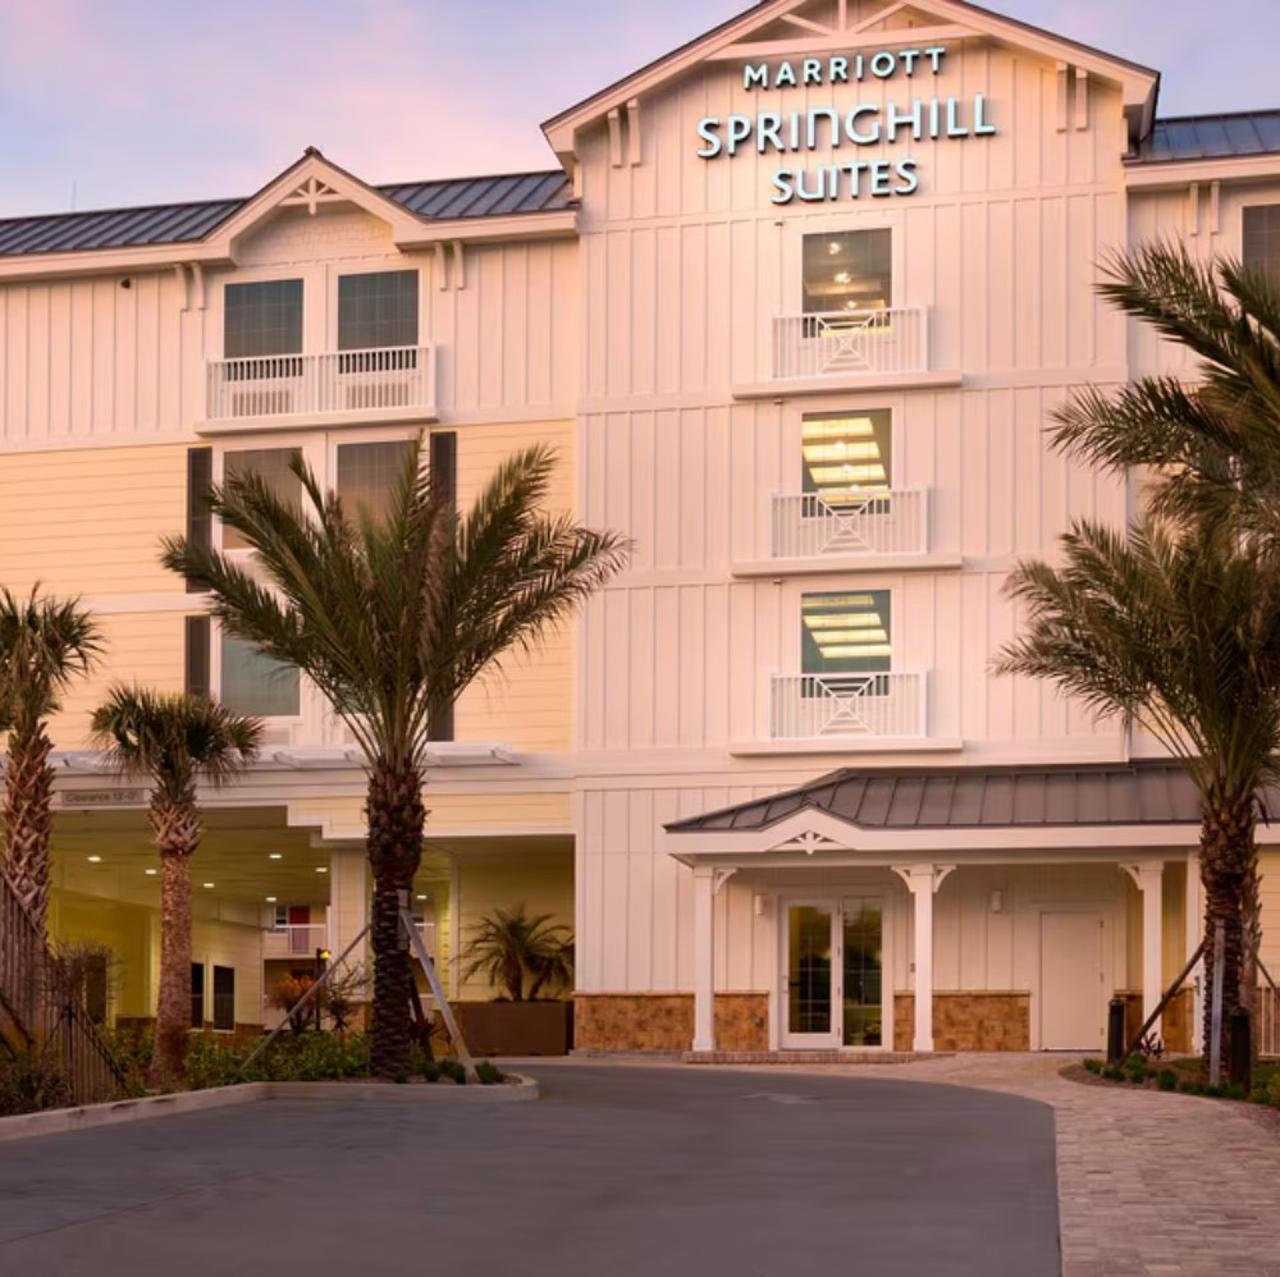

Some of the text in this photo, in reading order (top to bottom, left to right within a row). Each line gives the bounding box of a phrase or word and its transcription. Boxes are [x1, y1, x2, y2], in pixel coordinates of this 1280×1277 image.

[743, 47, 946, 90] MARRIOTT
[696, 92, 998, 158] SPRINGHILL
[770, 157, 919, 204] SUITES
